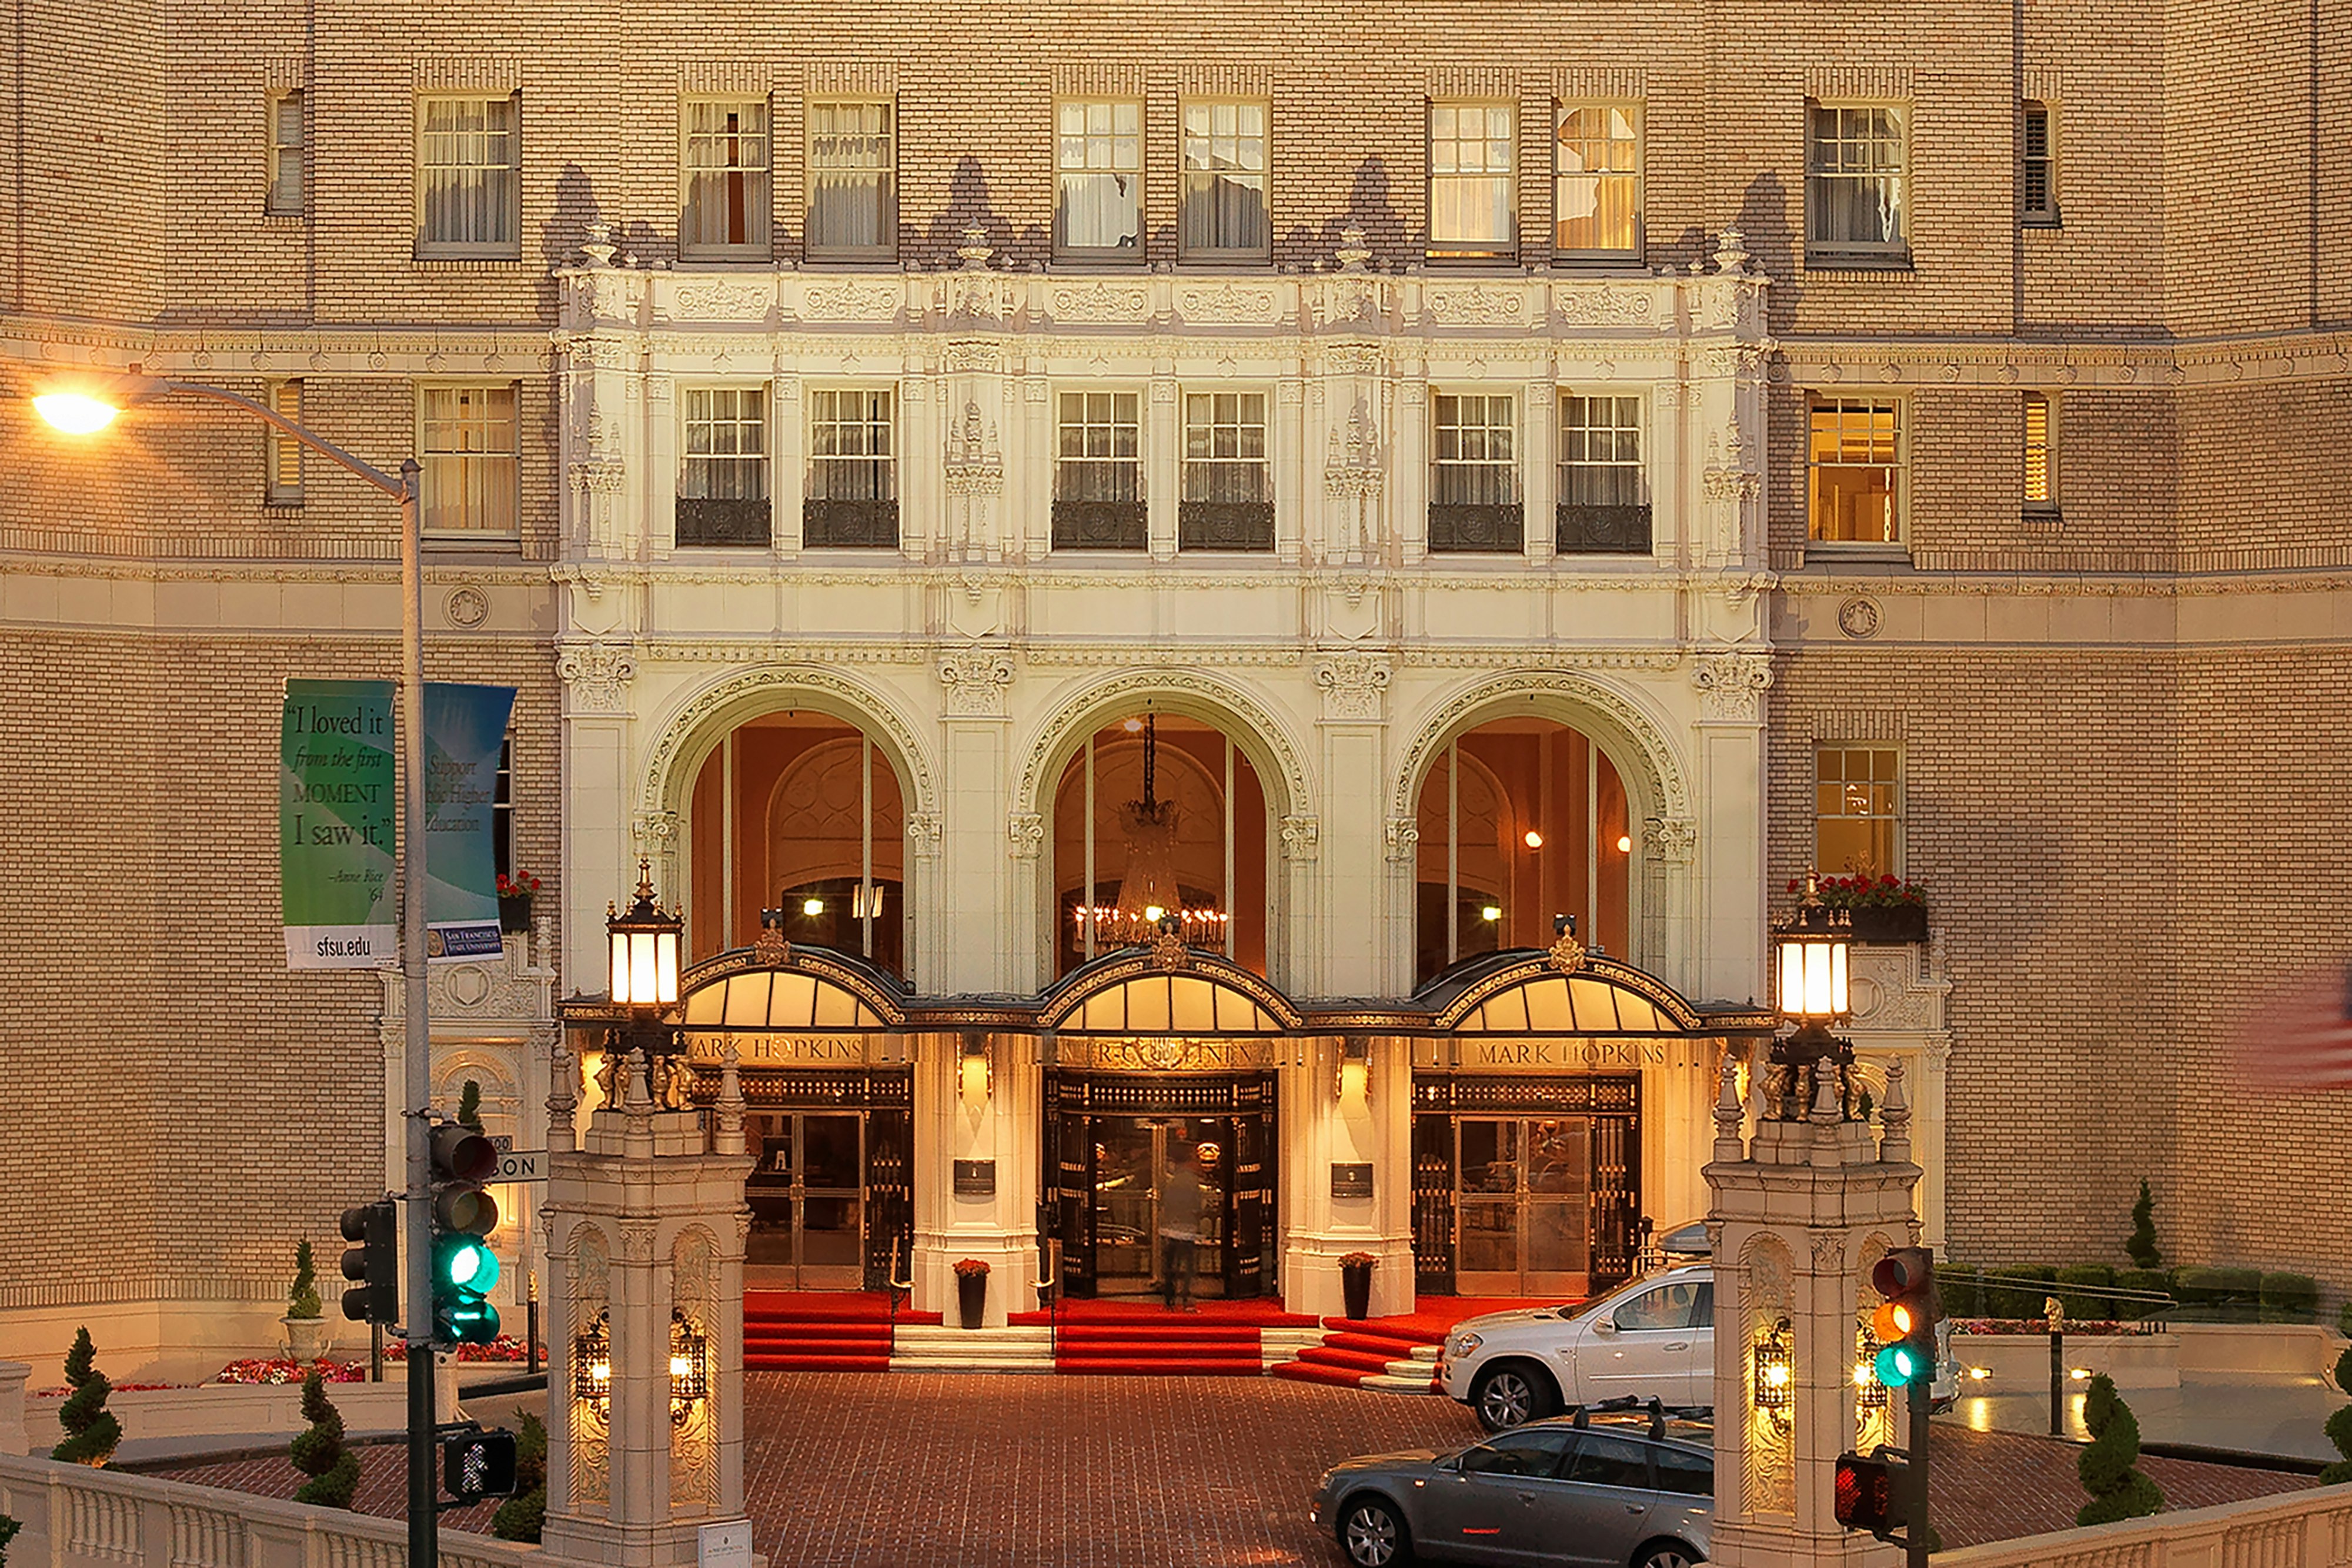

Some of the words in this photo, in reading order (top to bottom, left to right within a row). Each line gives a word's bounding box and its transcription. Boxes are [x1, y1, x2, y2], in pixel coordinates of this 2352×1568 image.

[310, 706, 362, 734] loved
[369, 708, 383, 734] it
[290, 745, 328, 773] from
[331, 746, 353, 767] the
[352, 747, 382, 773] first
[429, 754, 477, 781] Support
[292, 783, 382, 804] MOMENT
[293, 814, 304, 845] I
[312, 825, 355, 845] saw
[318, 936, 370, 957] sfsu.edu
[689, 1038, 743, 1057] ARK
[754, 1038, 861, 1058] HOPKINS
[1479, 1044, 1551, 1064] MARK
[1563, 1044, 1665, 1065] HOPKINS
